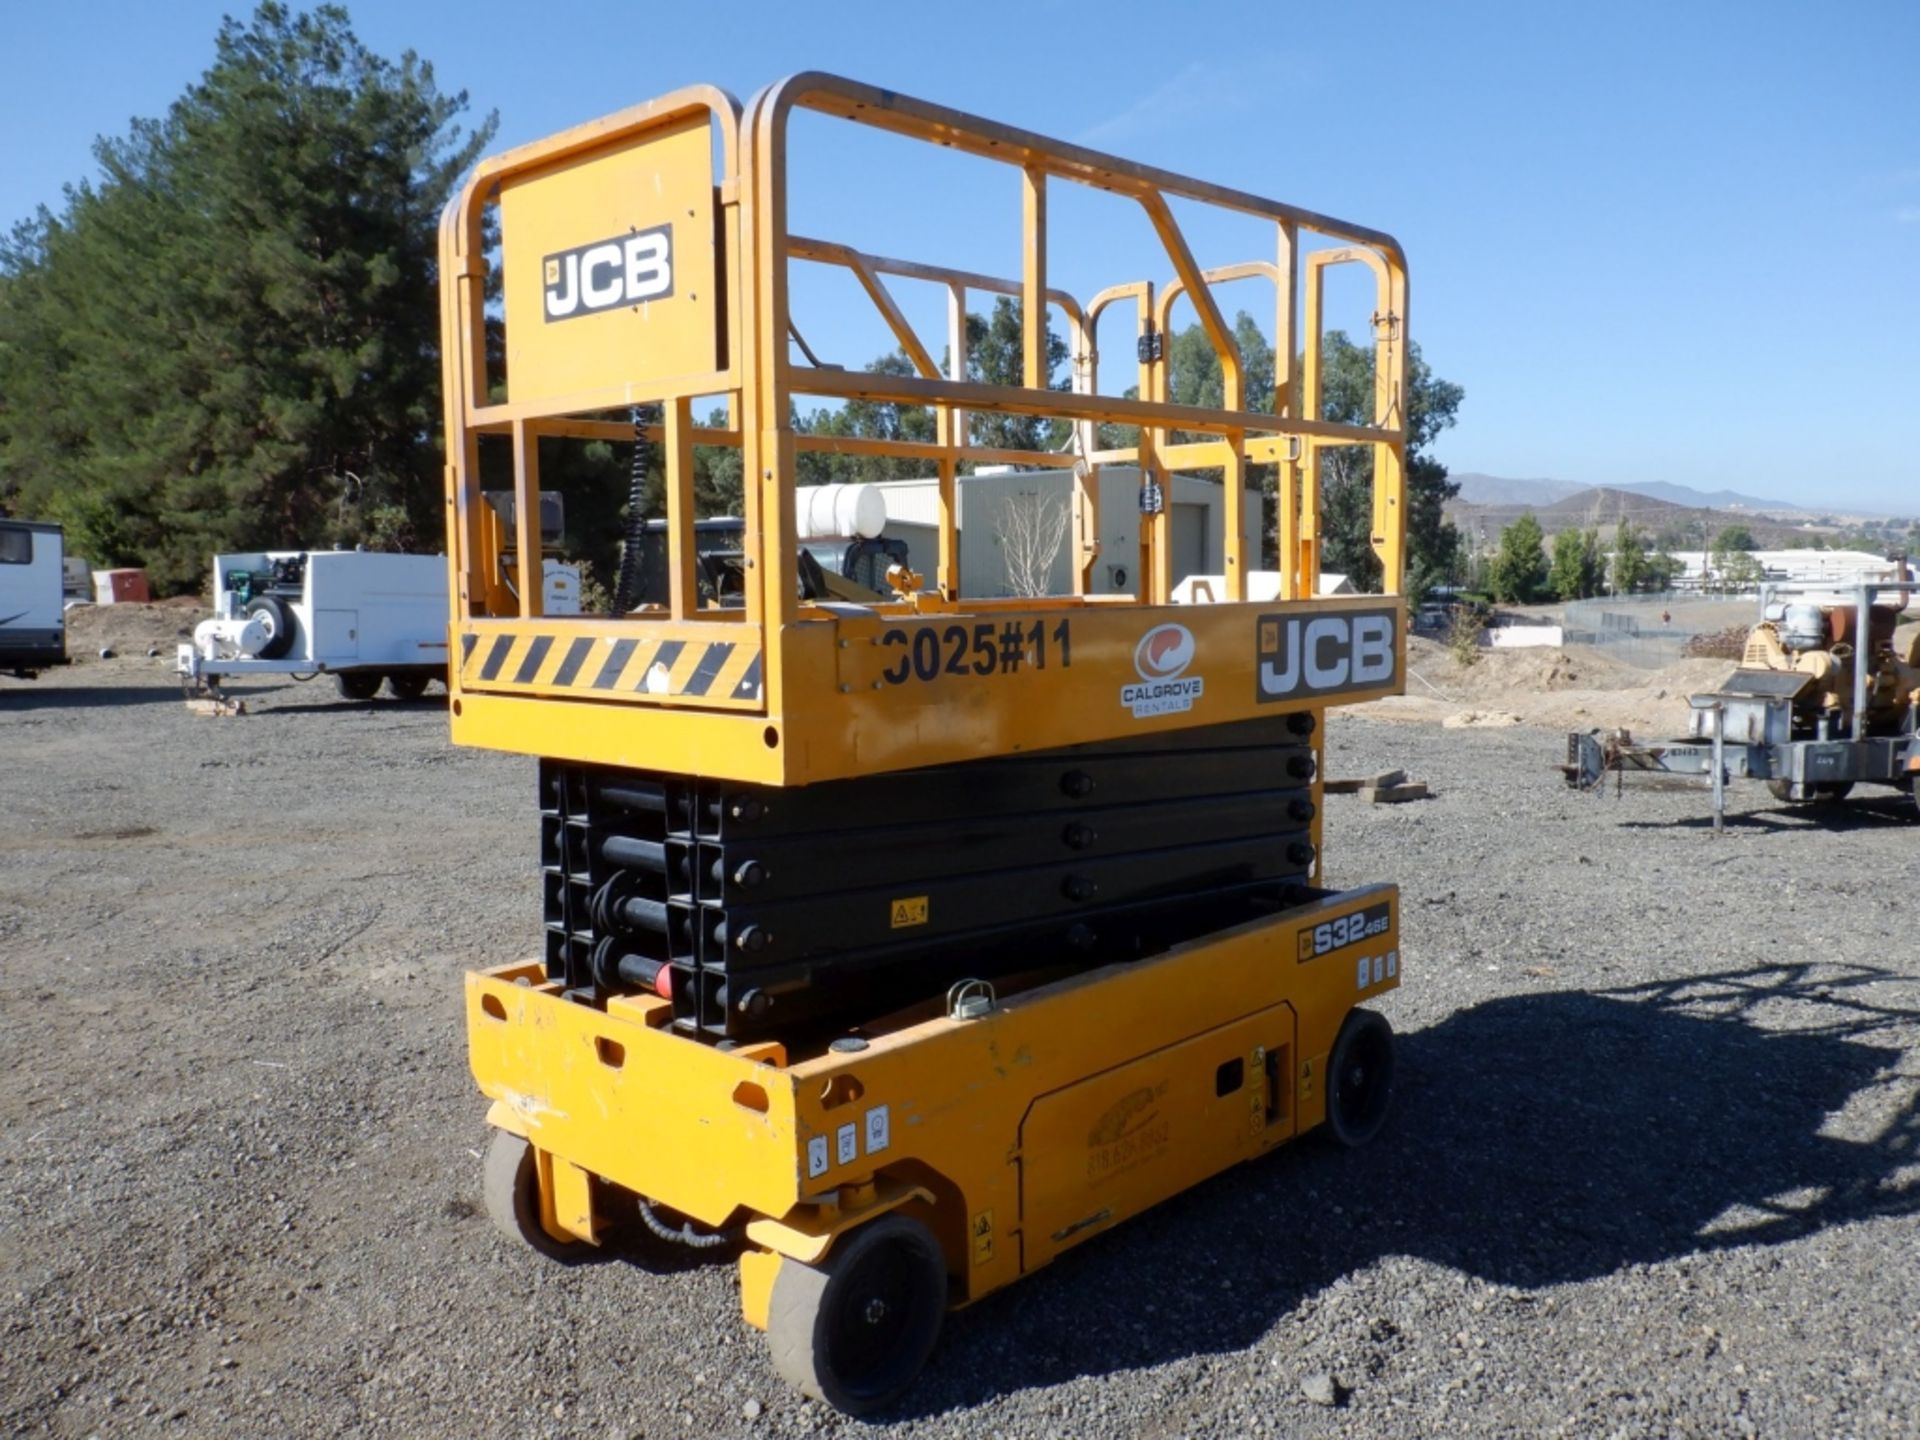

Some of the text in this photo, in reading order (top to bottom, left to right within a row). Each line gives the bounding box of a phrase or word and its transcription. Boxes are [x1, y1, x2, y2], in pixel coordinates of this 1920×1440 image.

[546, 232, 671, 316] JCB
[1124, 680, 1200, 702] CALGROVE
[1261, 615, 1394, 695] JCB
